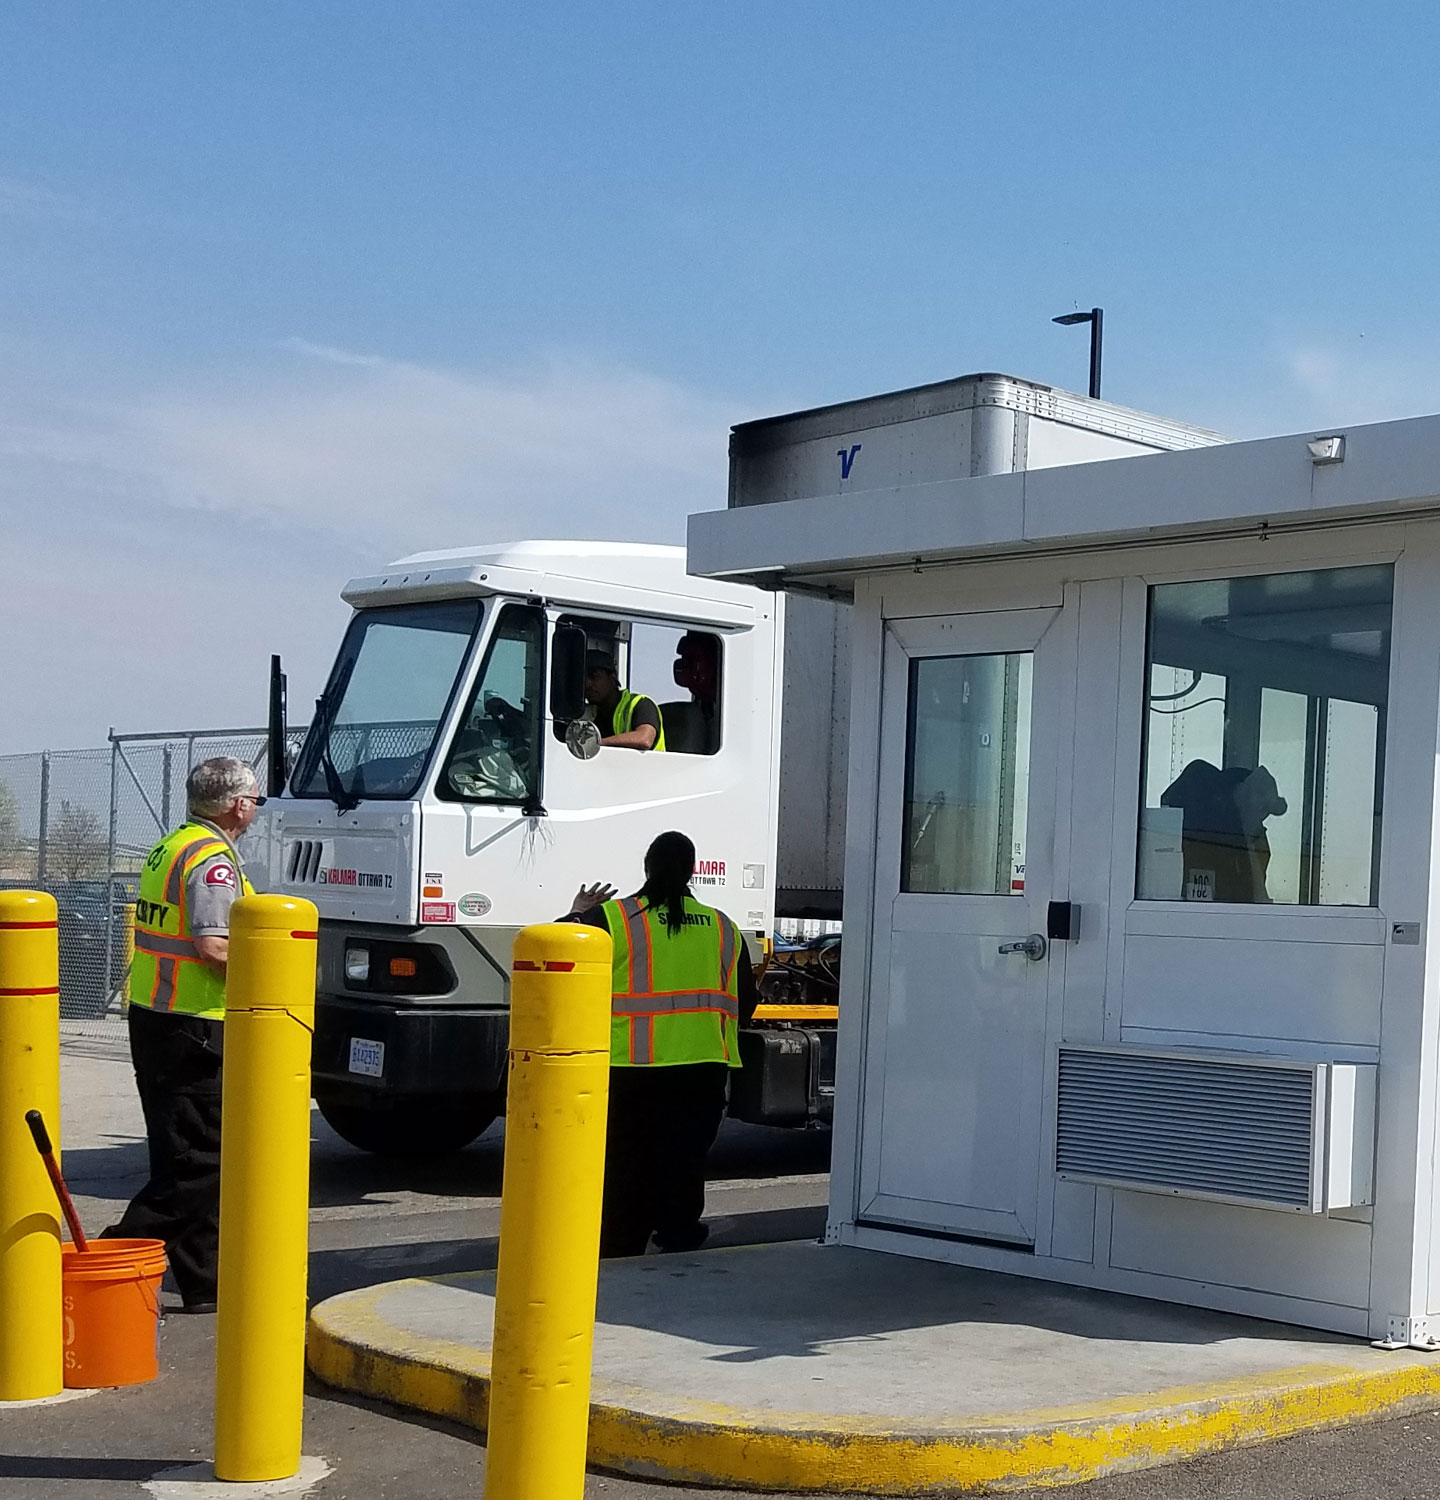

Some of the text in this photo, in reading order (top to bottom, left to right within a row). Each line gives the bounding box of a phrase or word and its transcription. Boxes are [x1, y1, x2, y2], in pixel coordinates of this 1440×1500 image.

[692, 860, 726, 876] LMAR
[328, 868, 393, 889] KALMAR OTTAWA T2
[718, 877, 726, 886] T2
